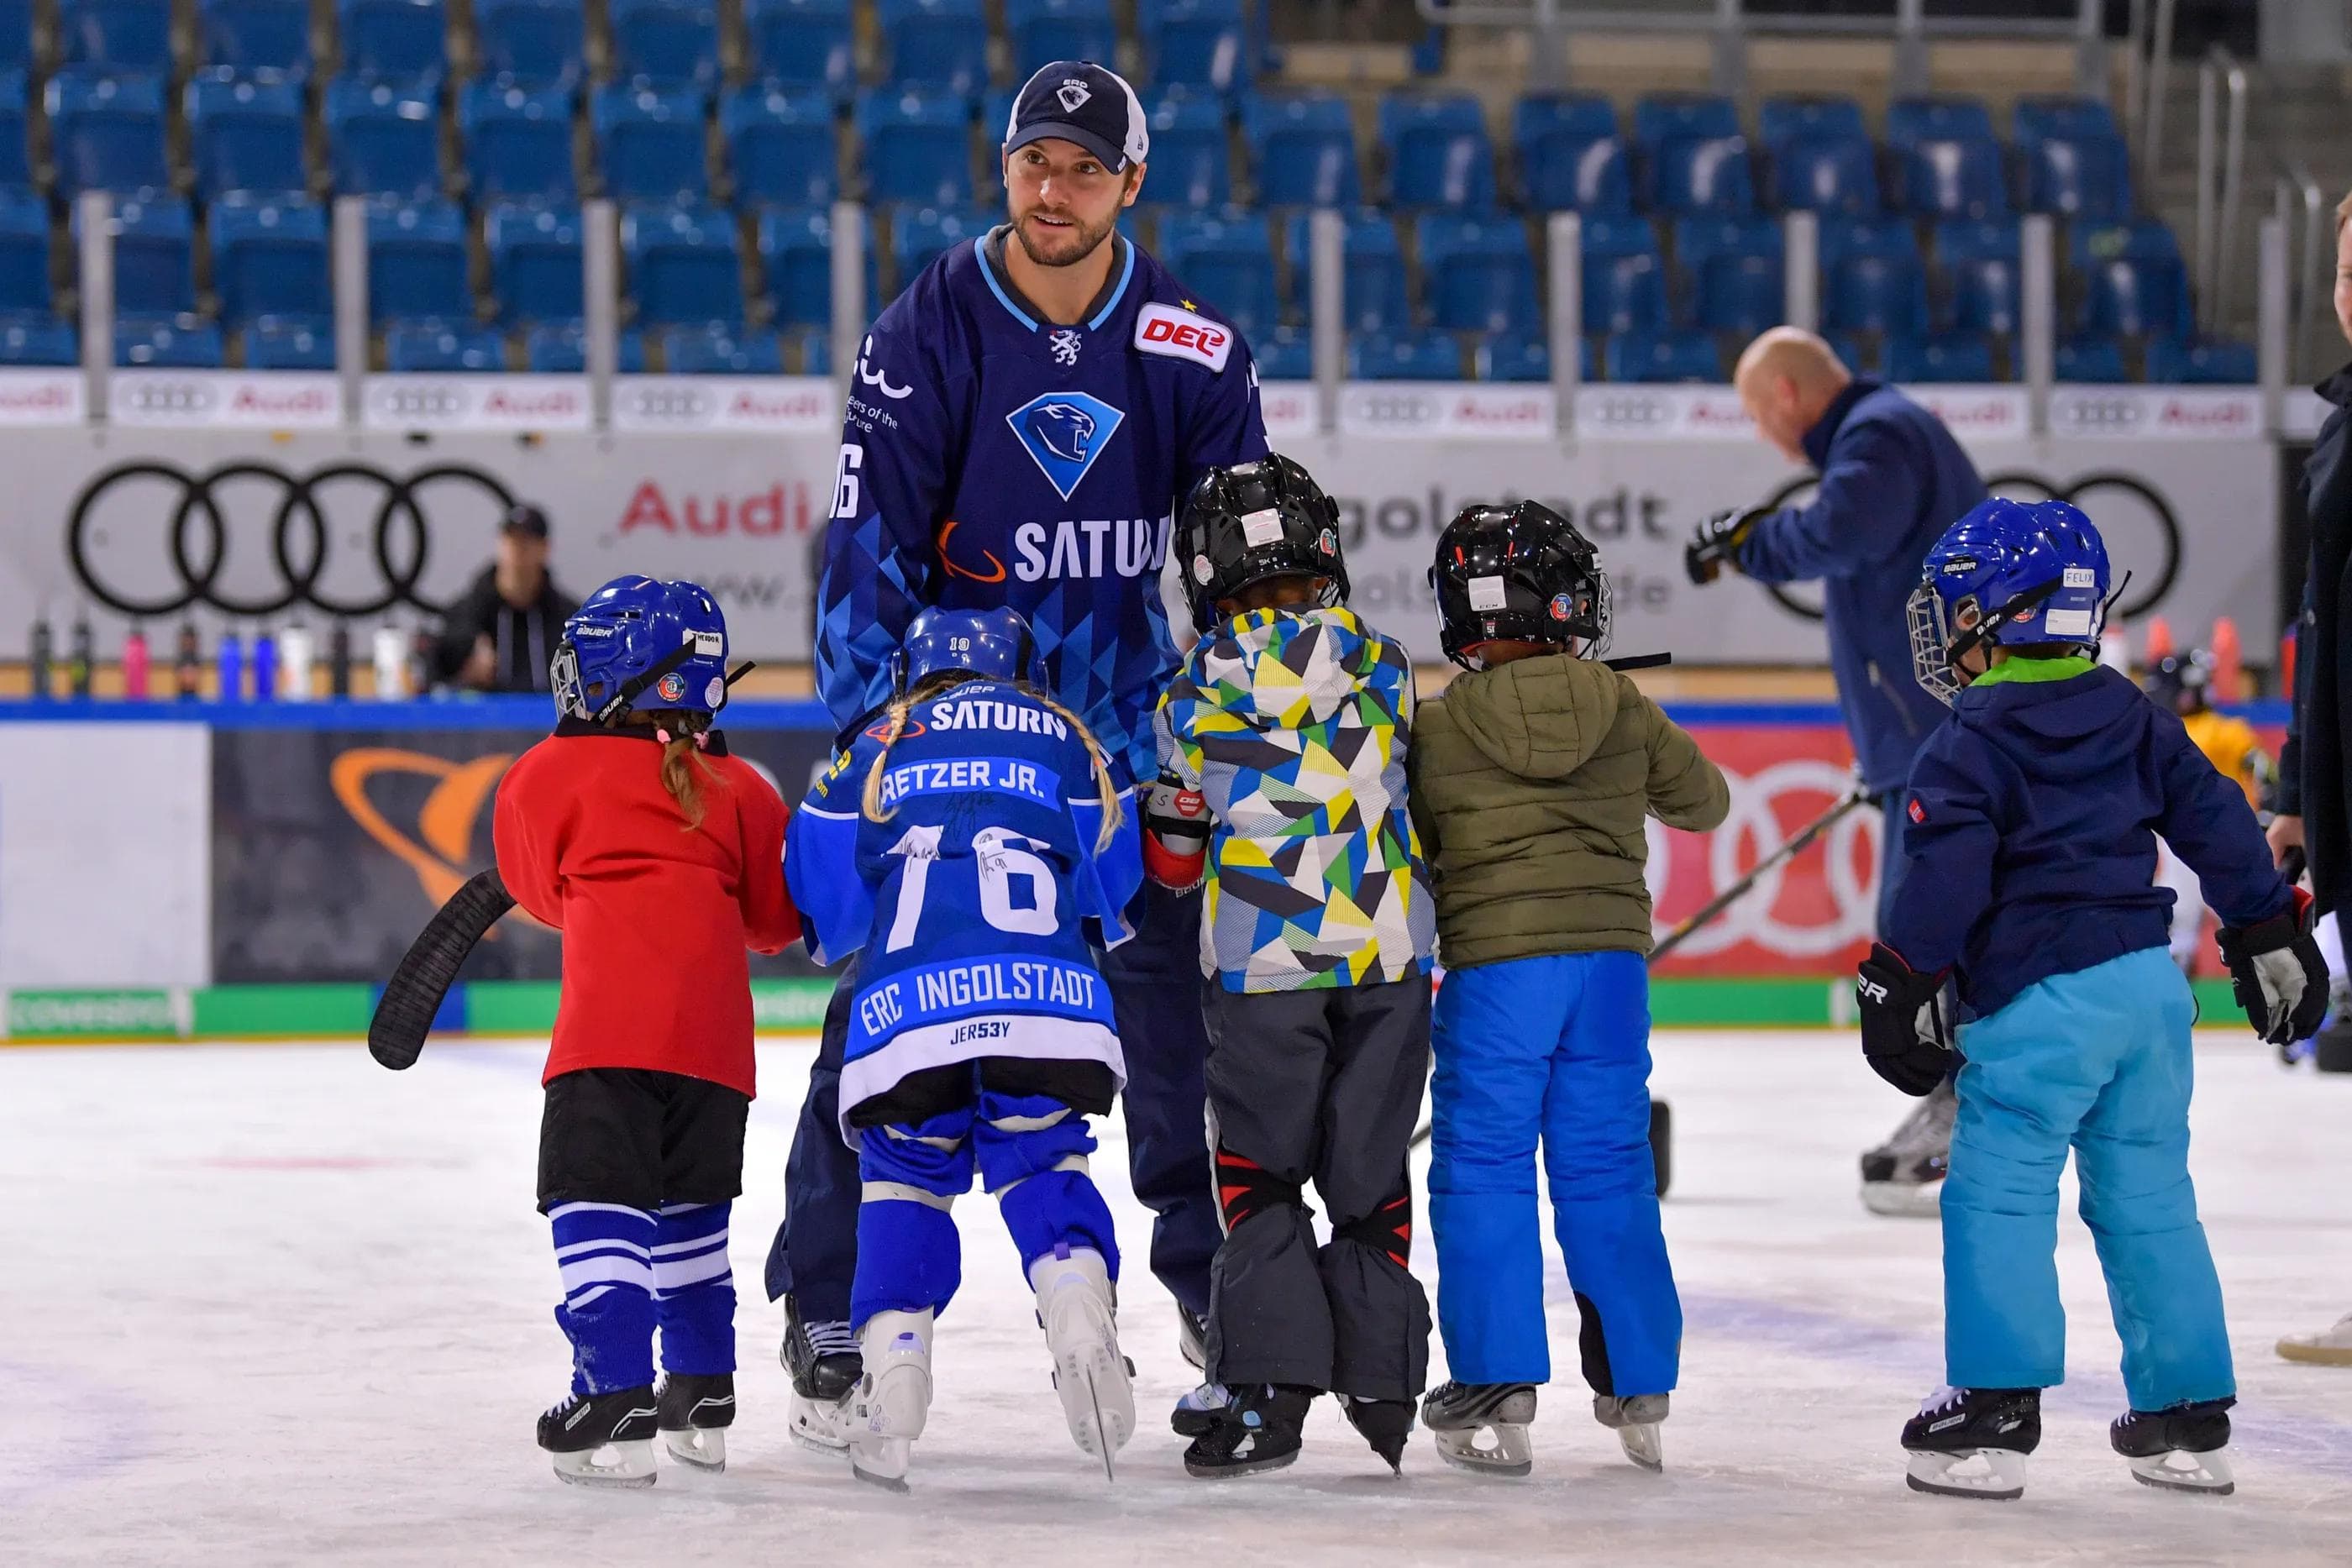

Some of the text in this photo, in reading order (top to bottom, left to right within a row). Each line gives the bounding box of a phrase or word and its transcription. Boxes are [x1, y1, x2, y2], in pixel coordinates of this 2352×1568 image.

[0, 385, 71, 410] udi
[485, 389, 580, 416] Audi
[727, 390, 821, 416] Audi
[868, 406, 883, 423] of
[882, 408, 898, 430] the
[1453, 397, 1543, 426] Audi
[618, 477, 812, 539] Audi
[1944, 561, 1977, 573] BAUER
[2066, 572, 2093, 583] FELIX
[576, 625, 614, 638] BAUER
[931, 700, 1068, 742] SATURN
[999, 762, 1045, 799] JR.
[860, 983, 903, 1036] ERC
[916, 962, 1095, 1012] INGOLSTADT
